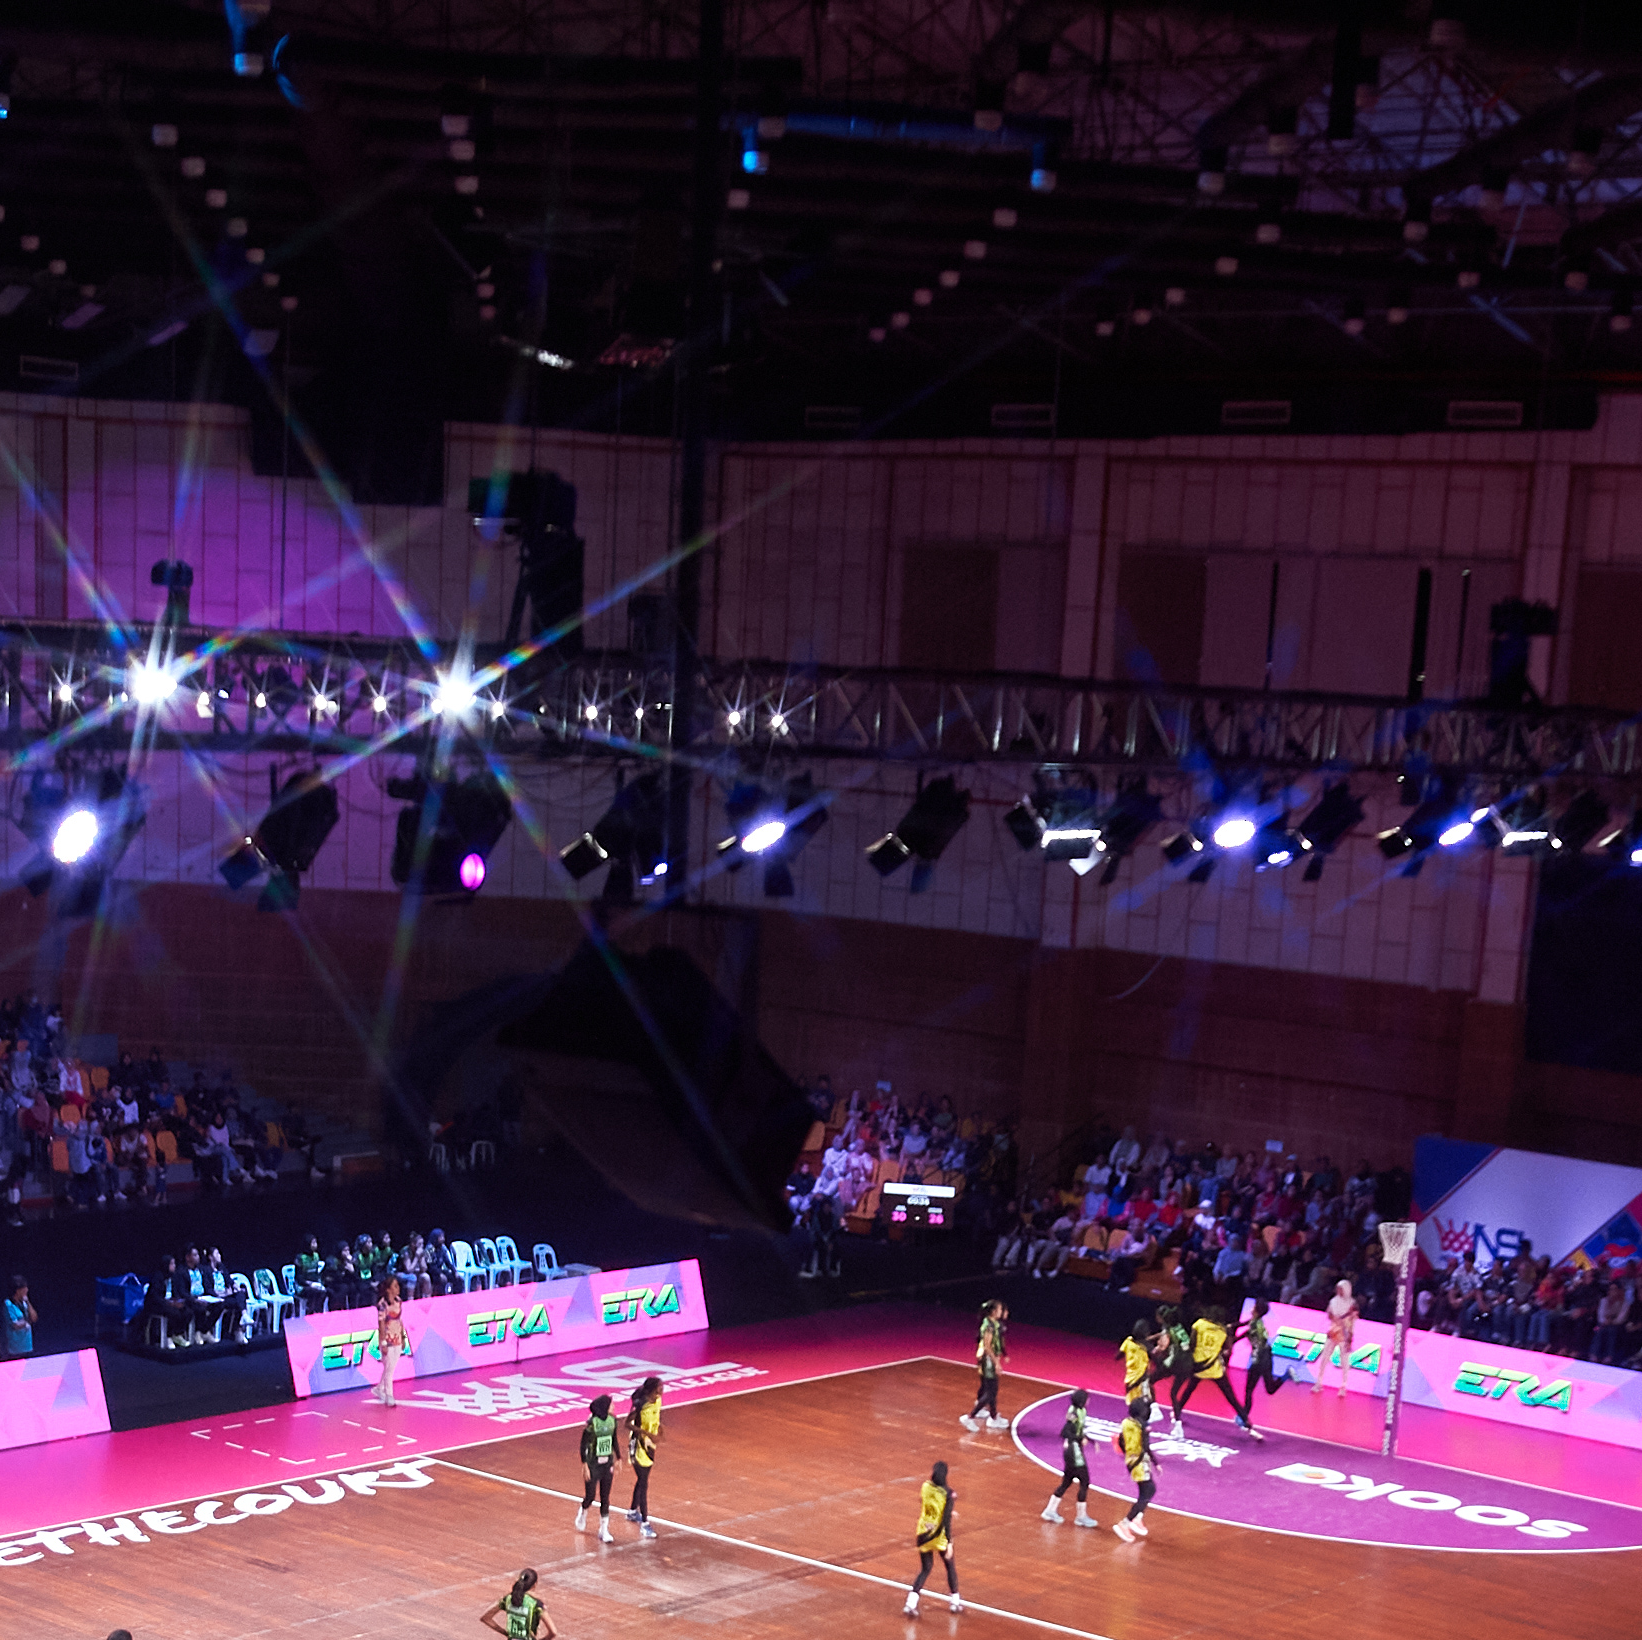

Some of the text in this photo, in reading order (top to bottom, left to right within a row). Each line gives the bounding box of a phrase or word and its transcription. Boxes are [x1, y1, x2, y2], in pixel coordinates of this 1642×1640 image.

[467, 1303, 552, 1346] ERA
[601, 1283, 680, 1325] ERA
[1453, 1361, 1574, 1413] ERA
[1264, 1462, 1589, 1539] sooka
